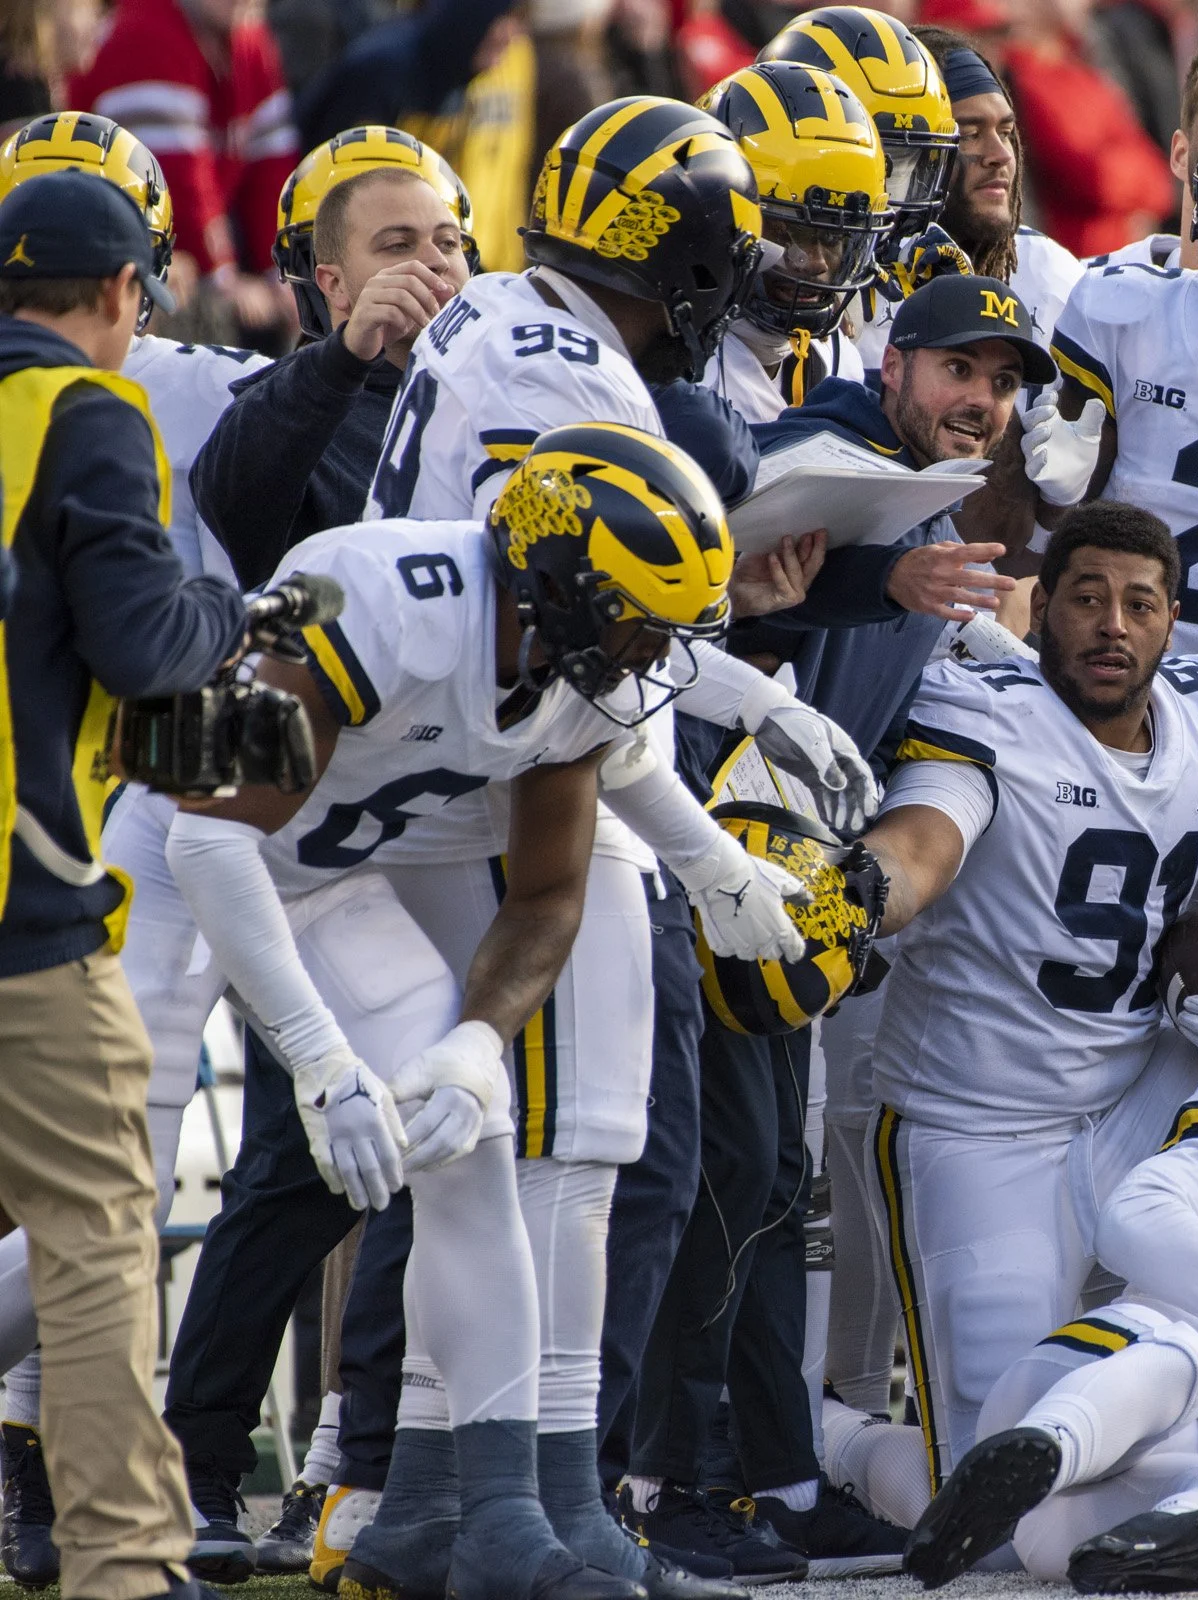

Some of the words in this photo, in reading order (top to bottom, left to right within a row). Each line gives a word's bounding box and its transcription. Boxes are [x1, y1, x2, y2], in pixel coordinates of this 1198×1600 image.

[828, 191, 847, 207] M
[980, 290, 1019, 328] M
[511, 322, 599, 366] 99
